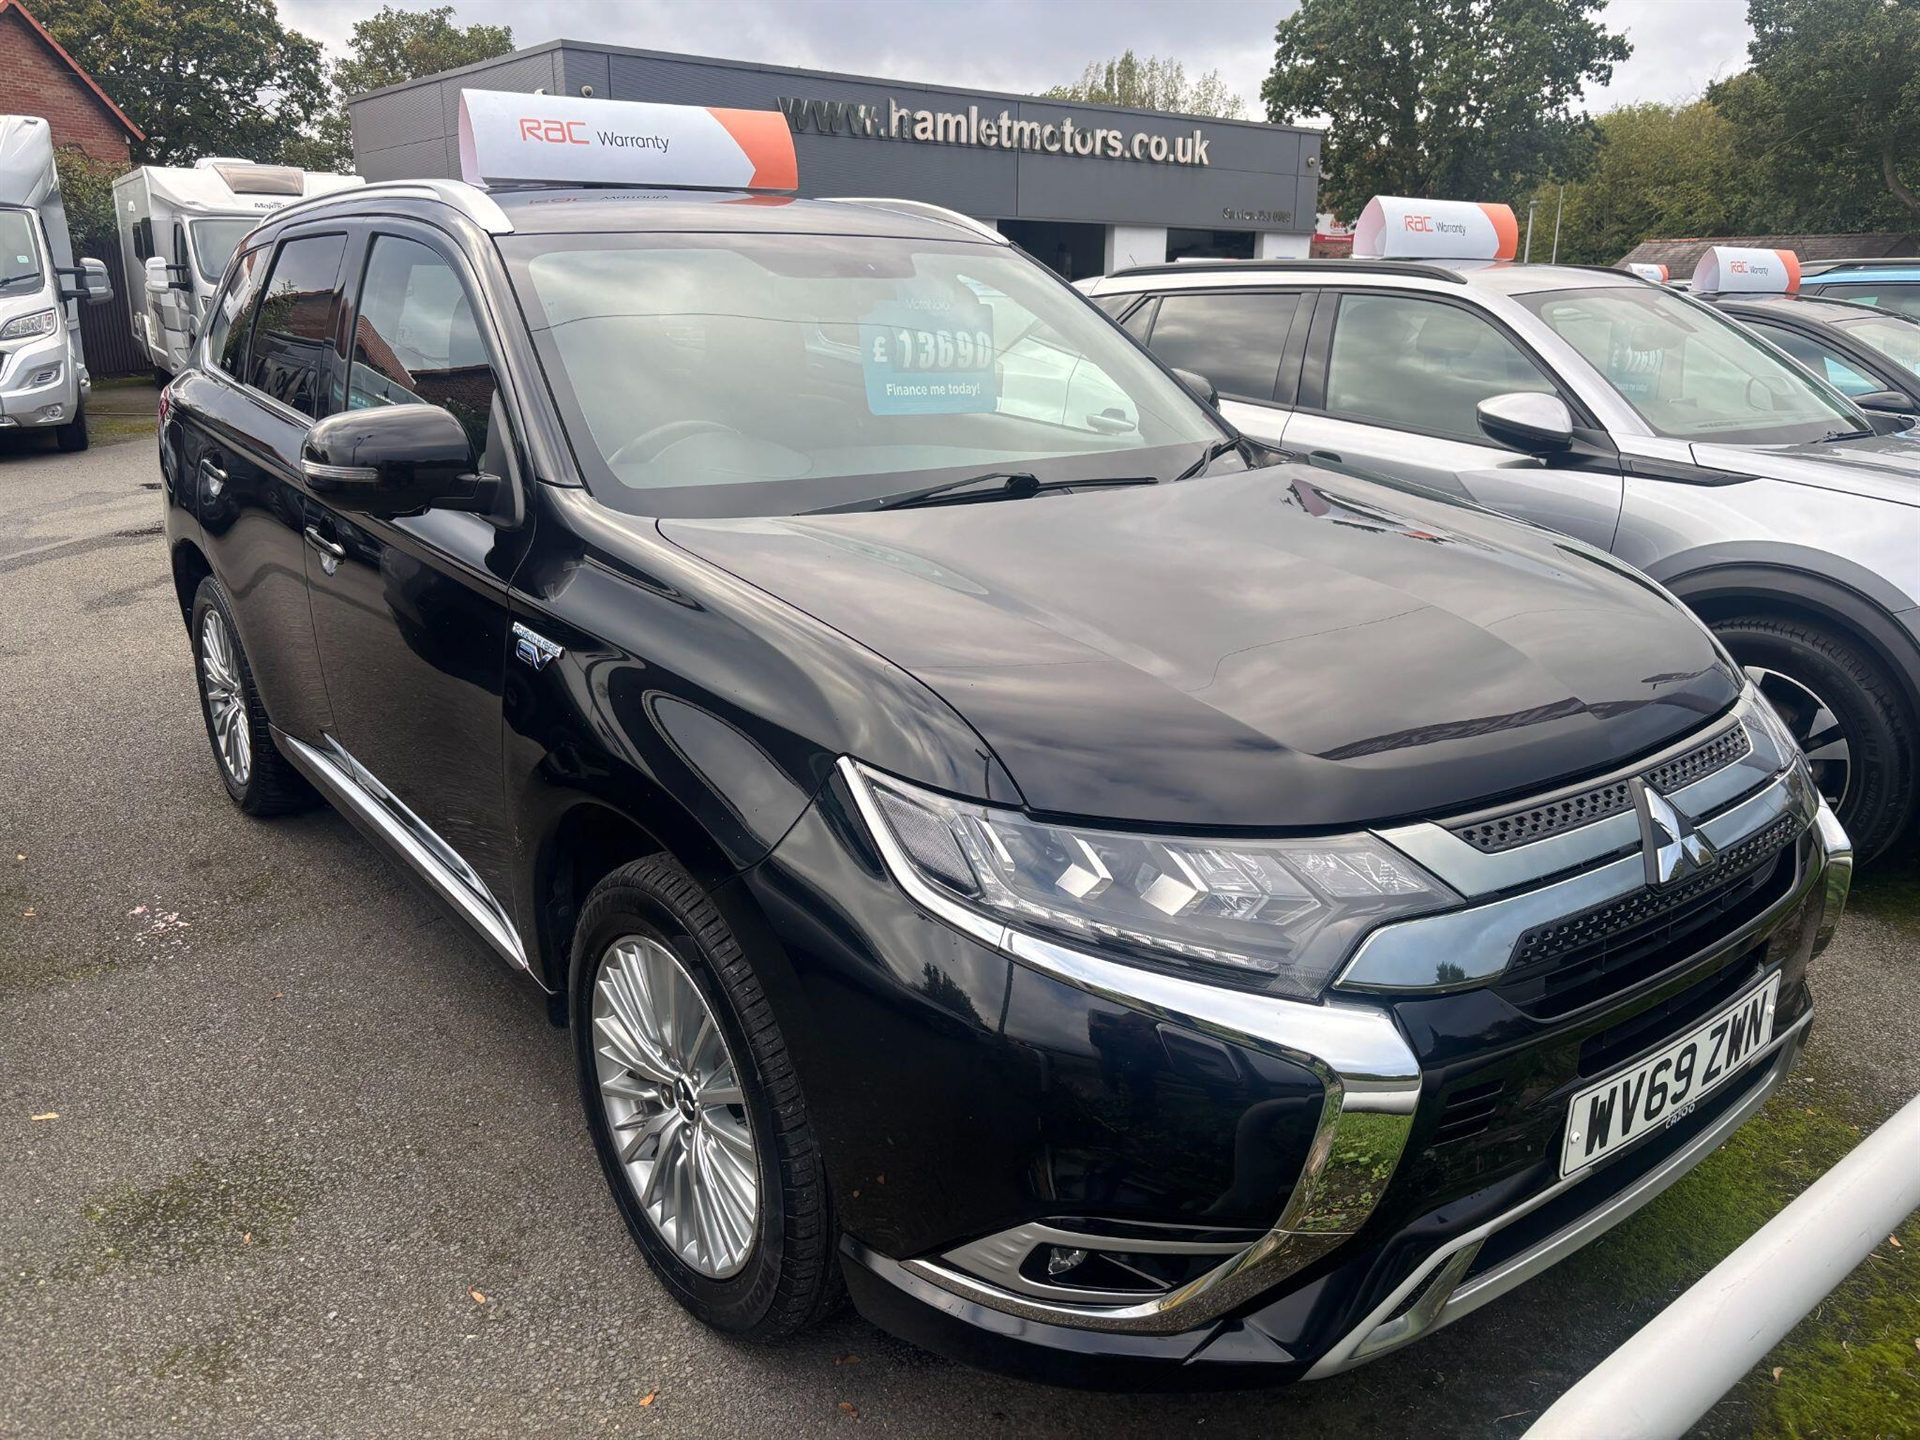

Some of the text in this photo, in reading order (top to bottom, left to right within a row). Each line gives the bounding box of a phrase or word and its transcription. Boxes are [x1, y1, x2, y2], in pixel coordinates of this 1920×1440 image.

[777, 96, 1210, 165] www.hamletmotors.co.uk
[596, 131, 670, 153] Warranty
[1435, 221, 1467, 237] Warranty
[886, 382, 981, 397] Finance me today!
[1584, 989, 1768, 1157] WV69 ZWN
